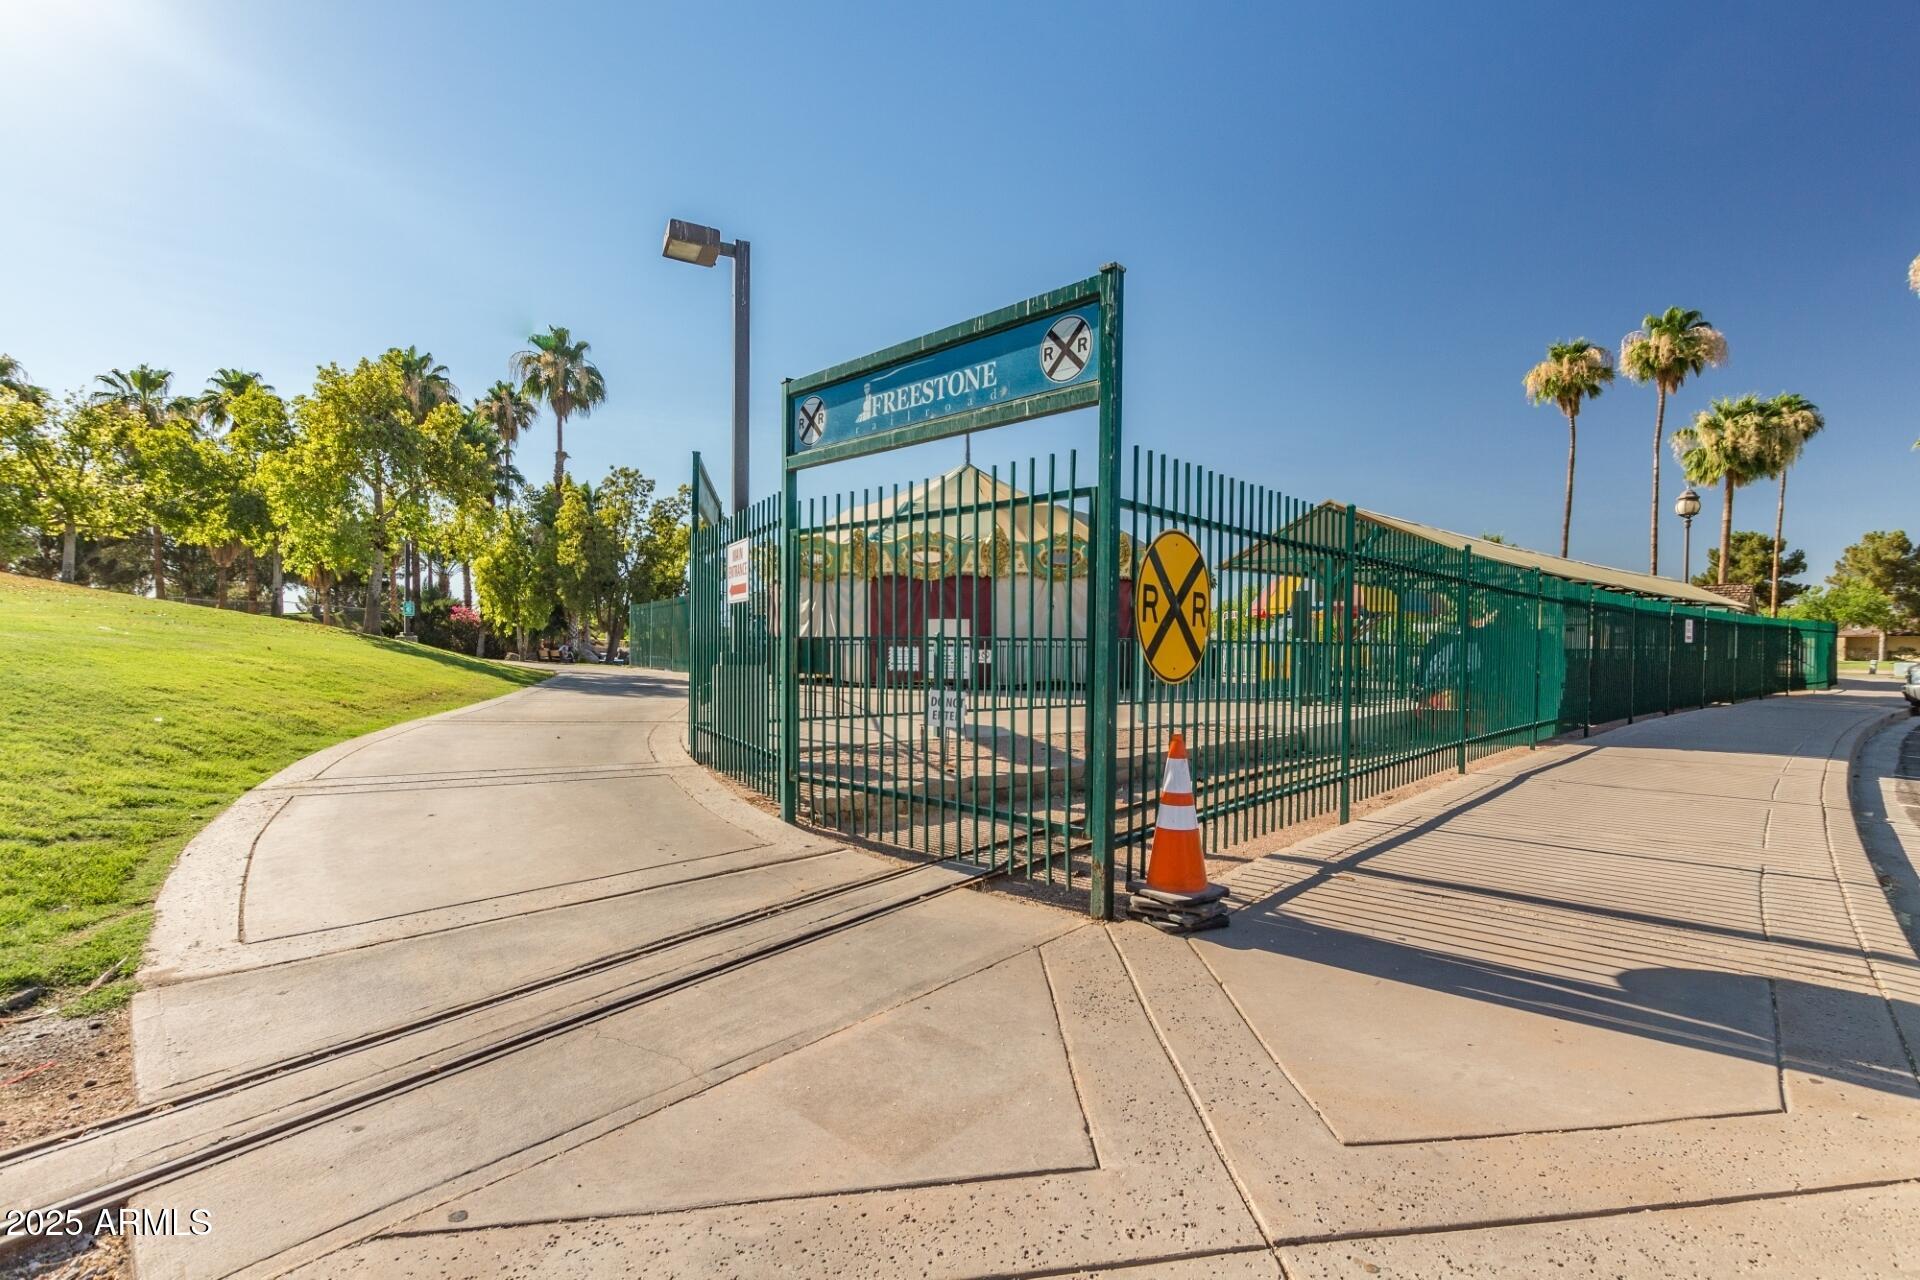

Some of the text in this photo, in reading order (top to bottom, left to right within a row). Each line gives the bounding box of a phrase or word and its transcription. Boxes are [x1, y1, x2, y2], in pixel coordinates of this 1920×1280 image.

[1044, 336, 1087, 362] R R
[871, 361, 997, 418] FREESTONE
[1142, 583, 1206, 628] R R
